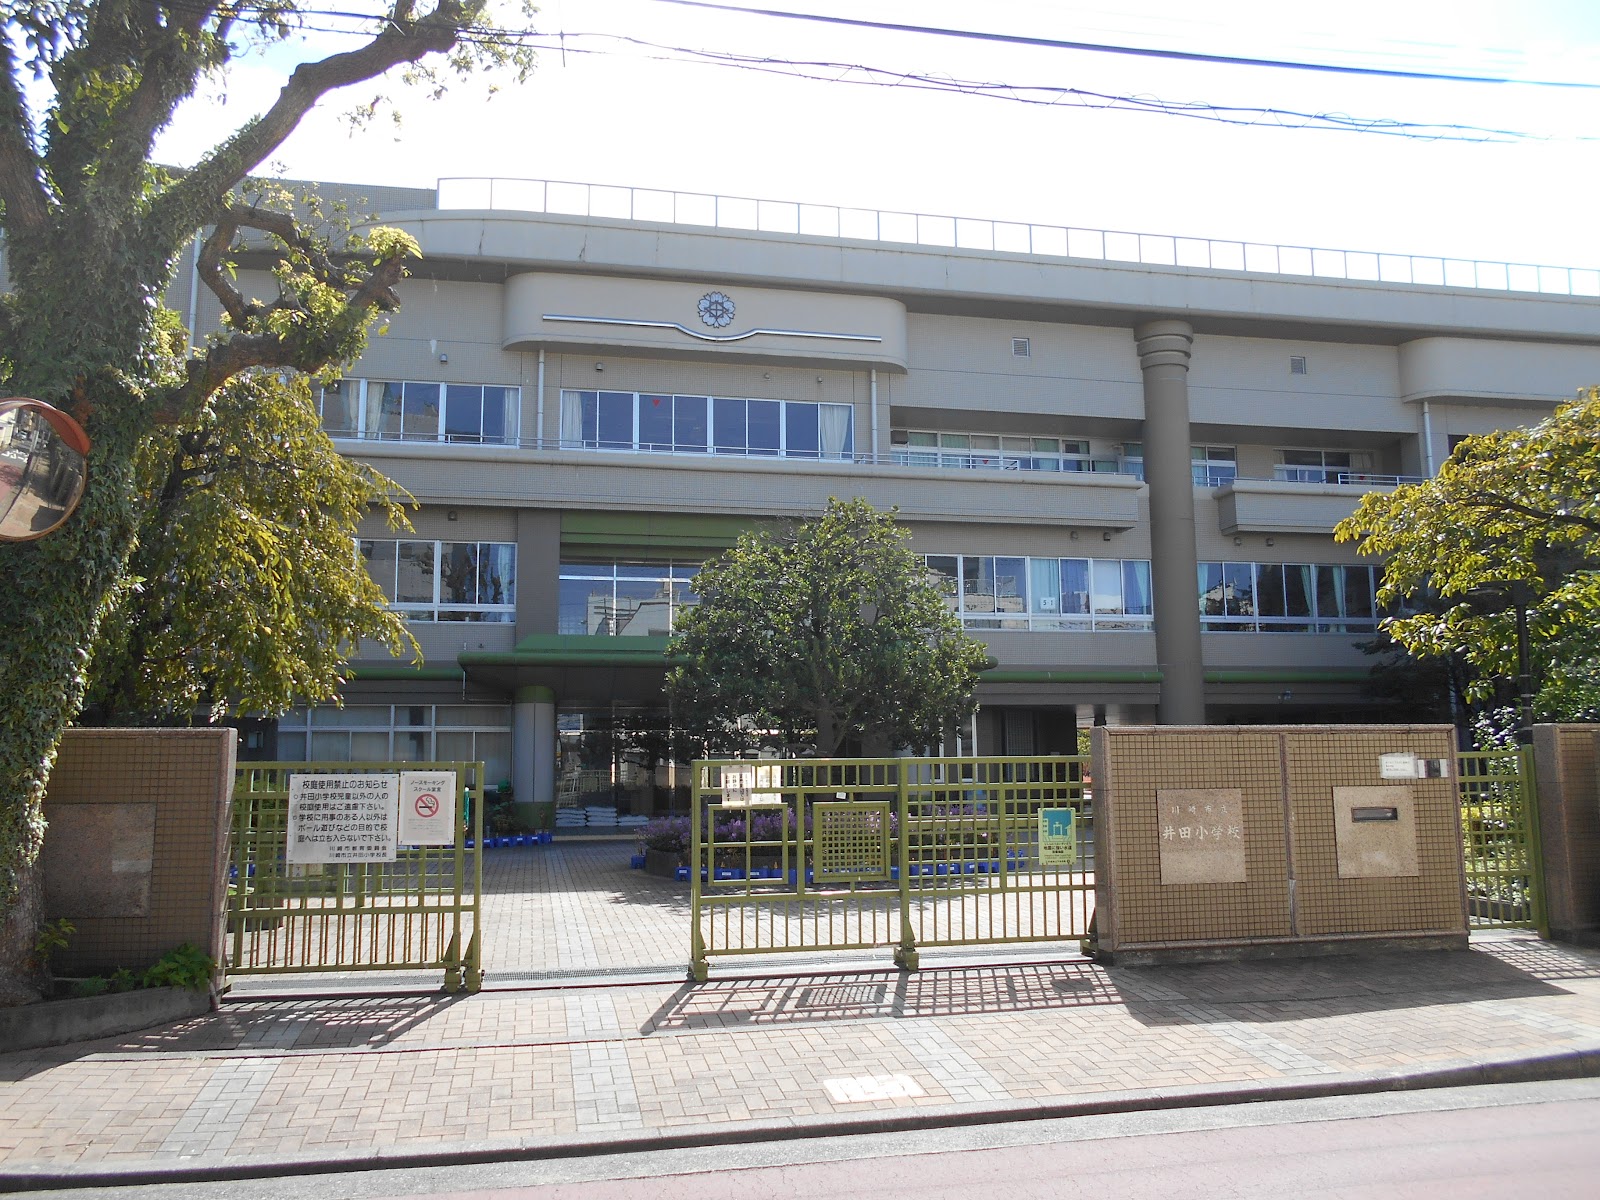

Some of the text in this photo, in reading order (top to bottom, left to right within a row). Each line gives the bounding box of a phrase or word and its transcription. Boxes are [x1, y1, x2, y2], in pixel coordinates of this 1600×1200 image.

[302, 779, 388, 790] 校庭使用禁止のお知らせ
[1171, 804, 1228, 815] 川崎市立
[297, 823, 388, 832] ボール遊びなどの目的で校
[1162, 825, 1240, 841] 井田小学校
